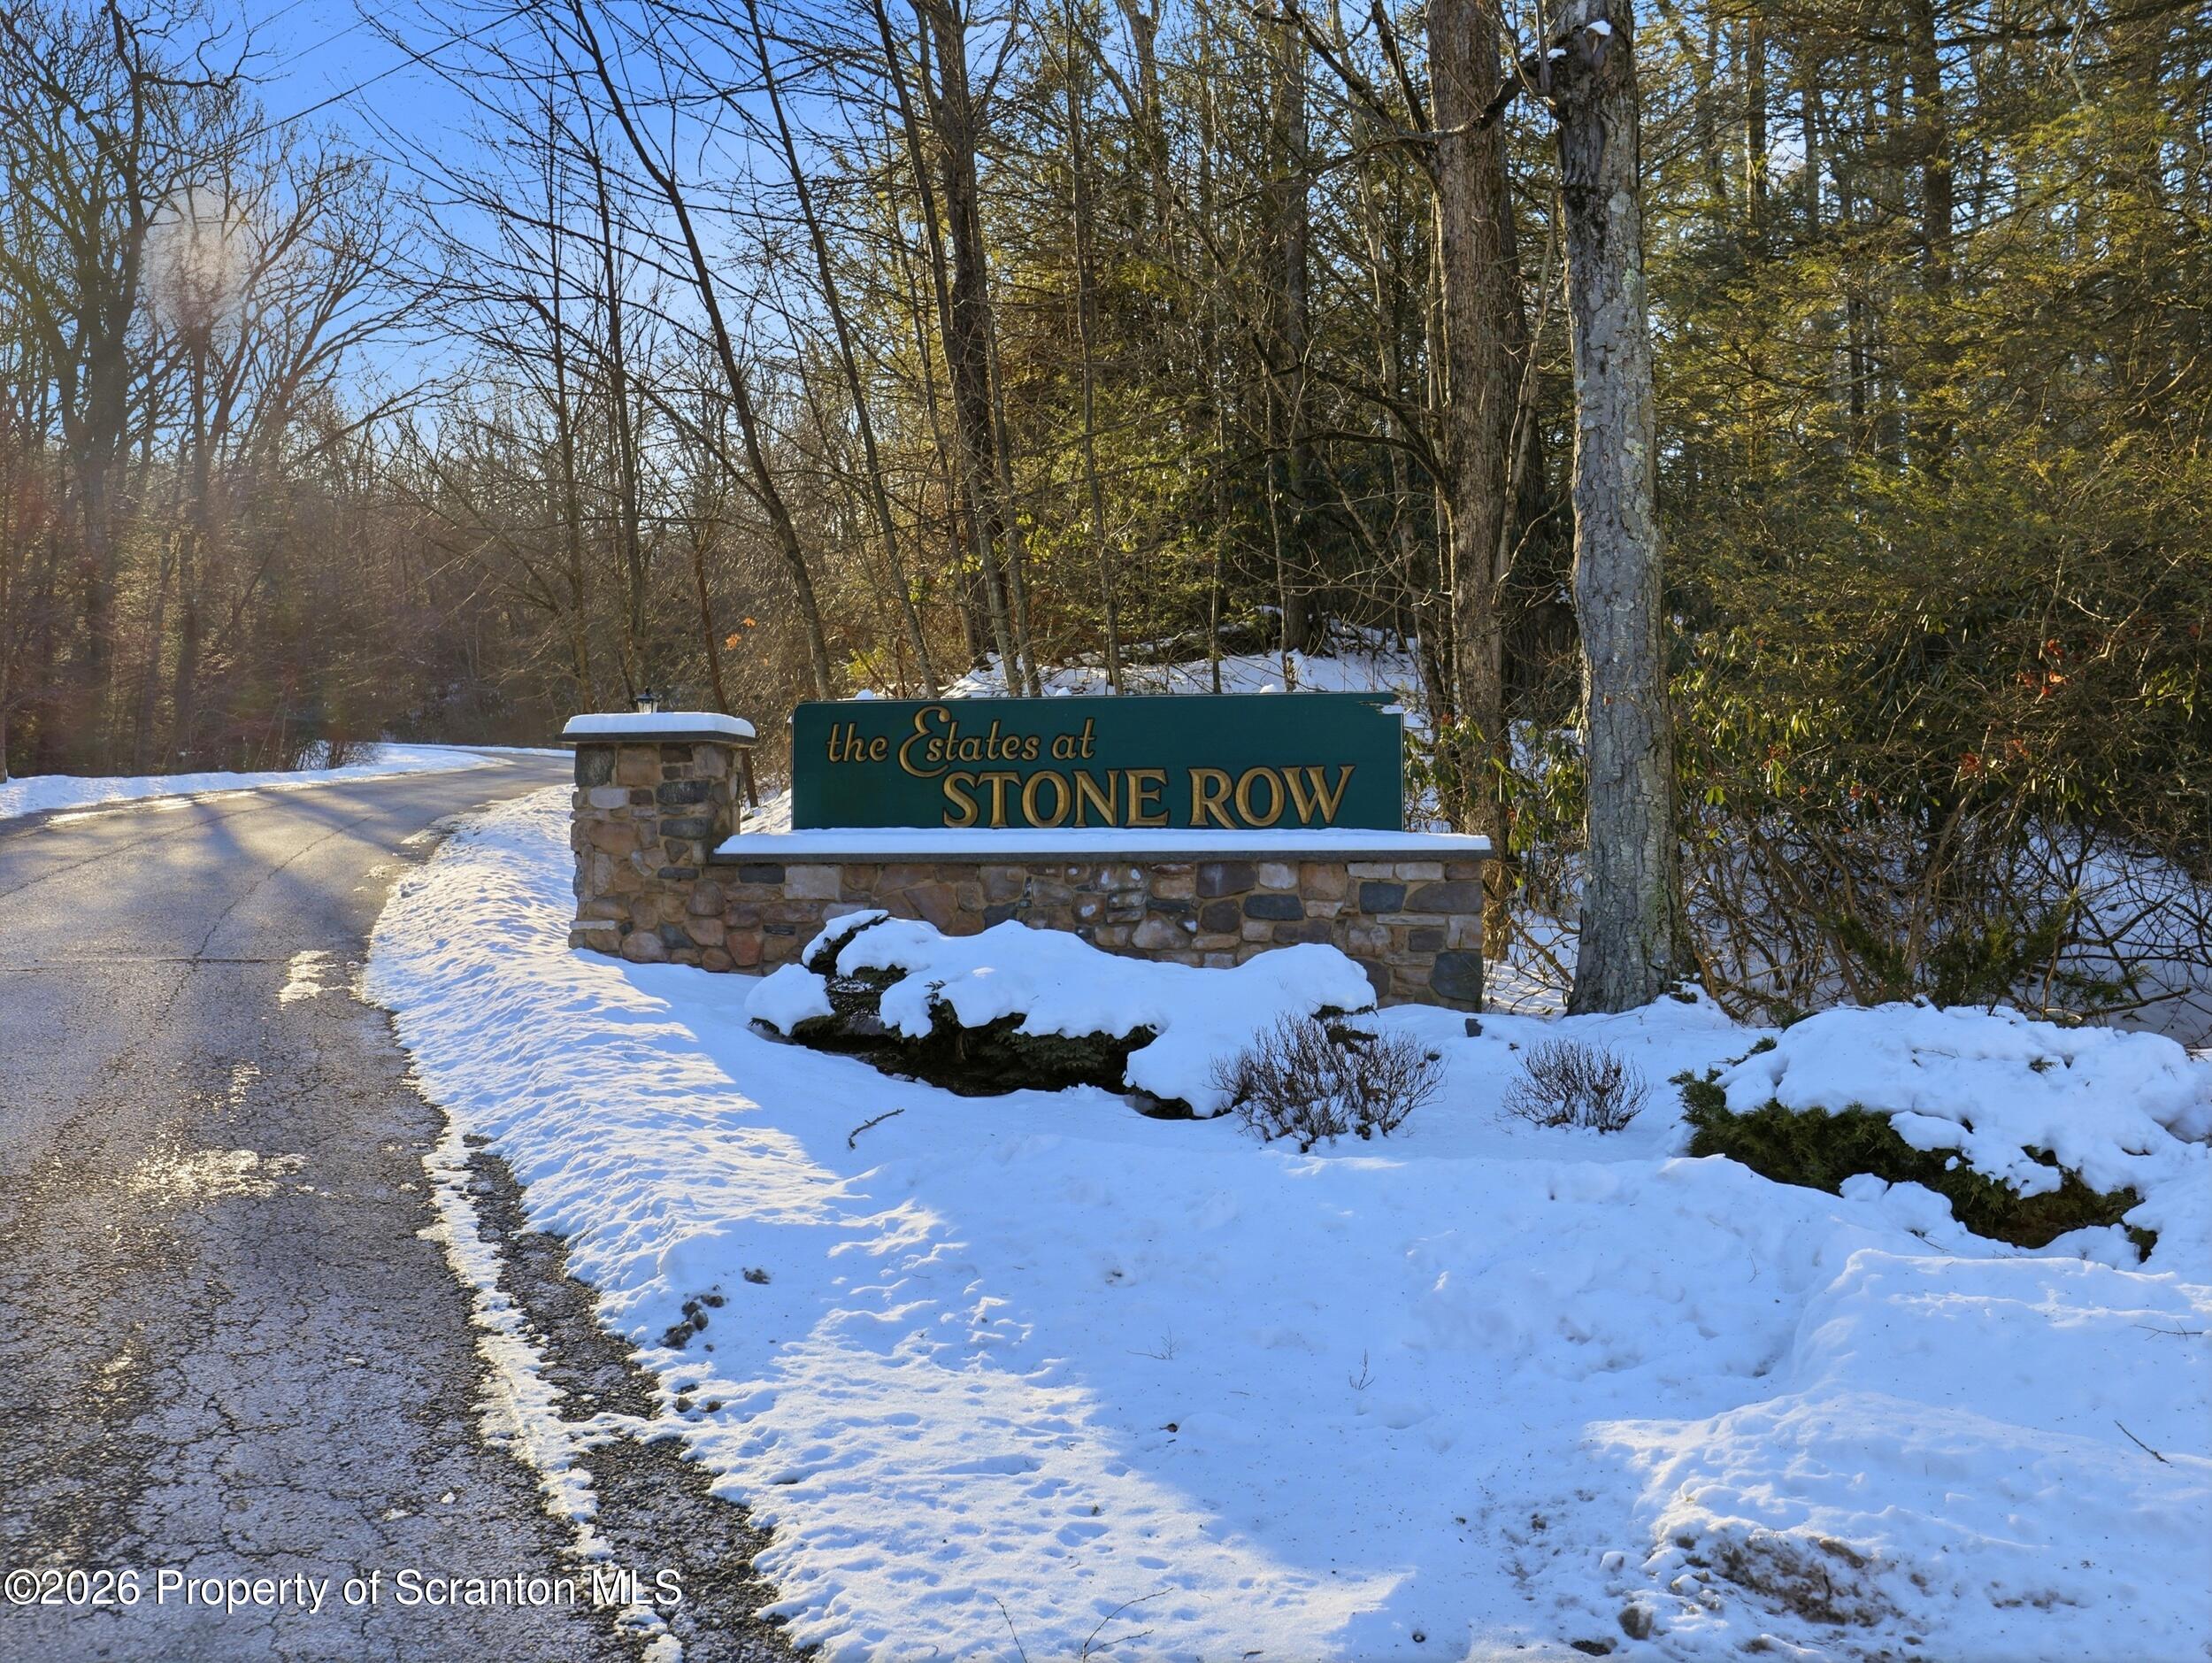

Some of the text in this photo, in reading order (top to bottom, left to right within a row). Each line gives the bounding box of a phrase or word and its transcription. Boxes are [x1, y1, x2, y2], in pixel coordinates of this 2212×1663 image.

[826, 705, 1096, 778] the Estates at
[943, 766, 1356, 829] STONE ROW
